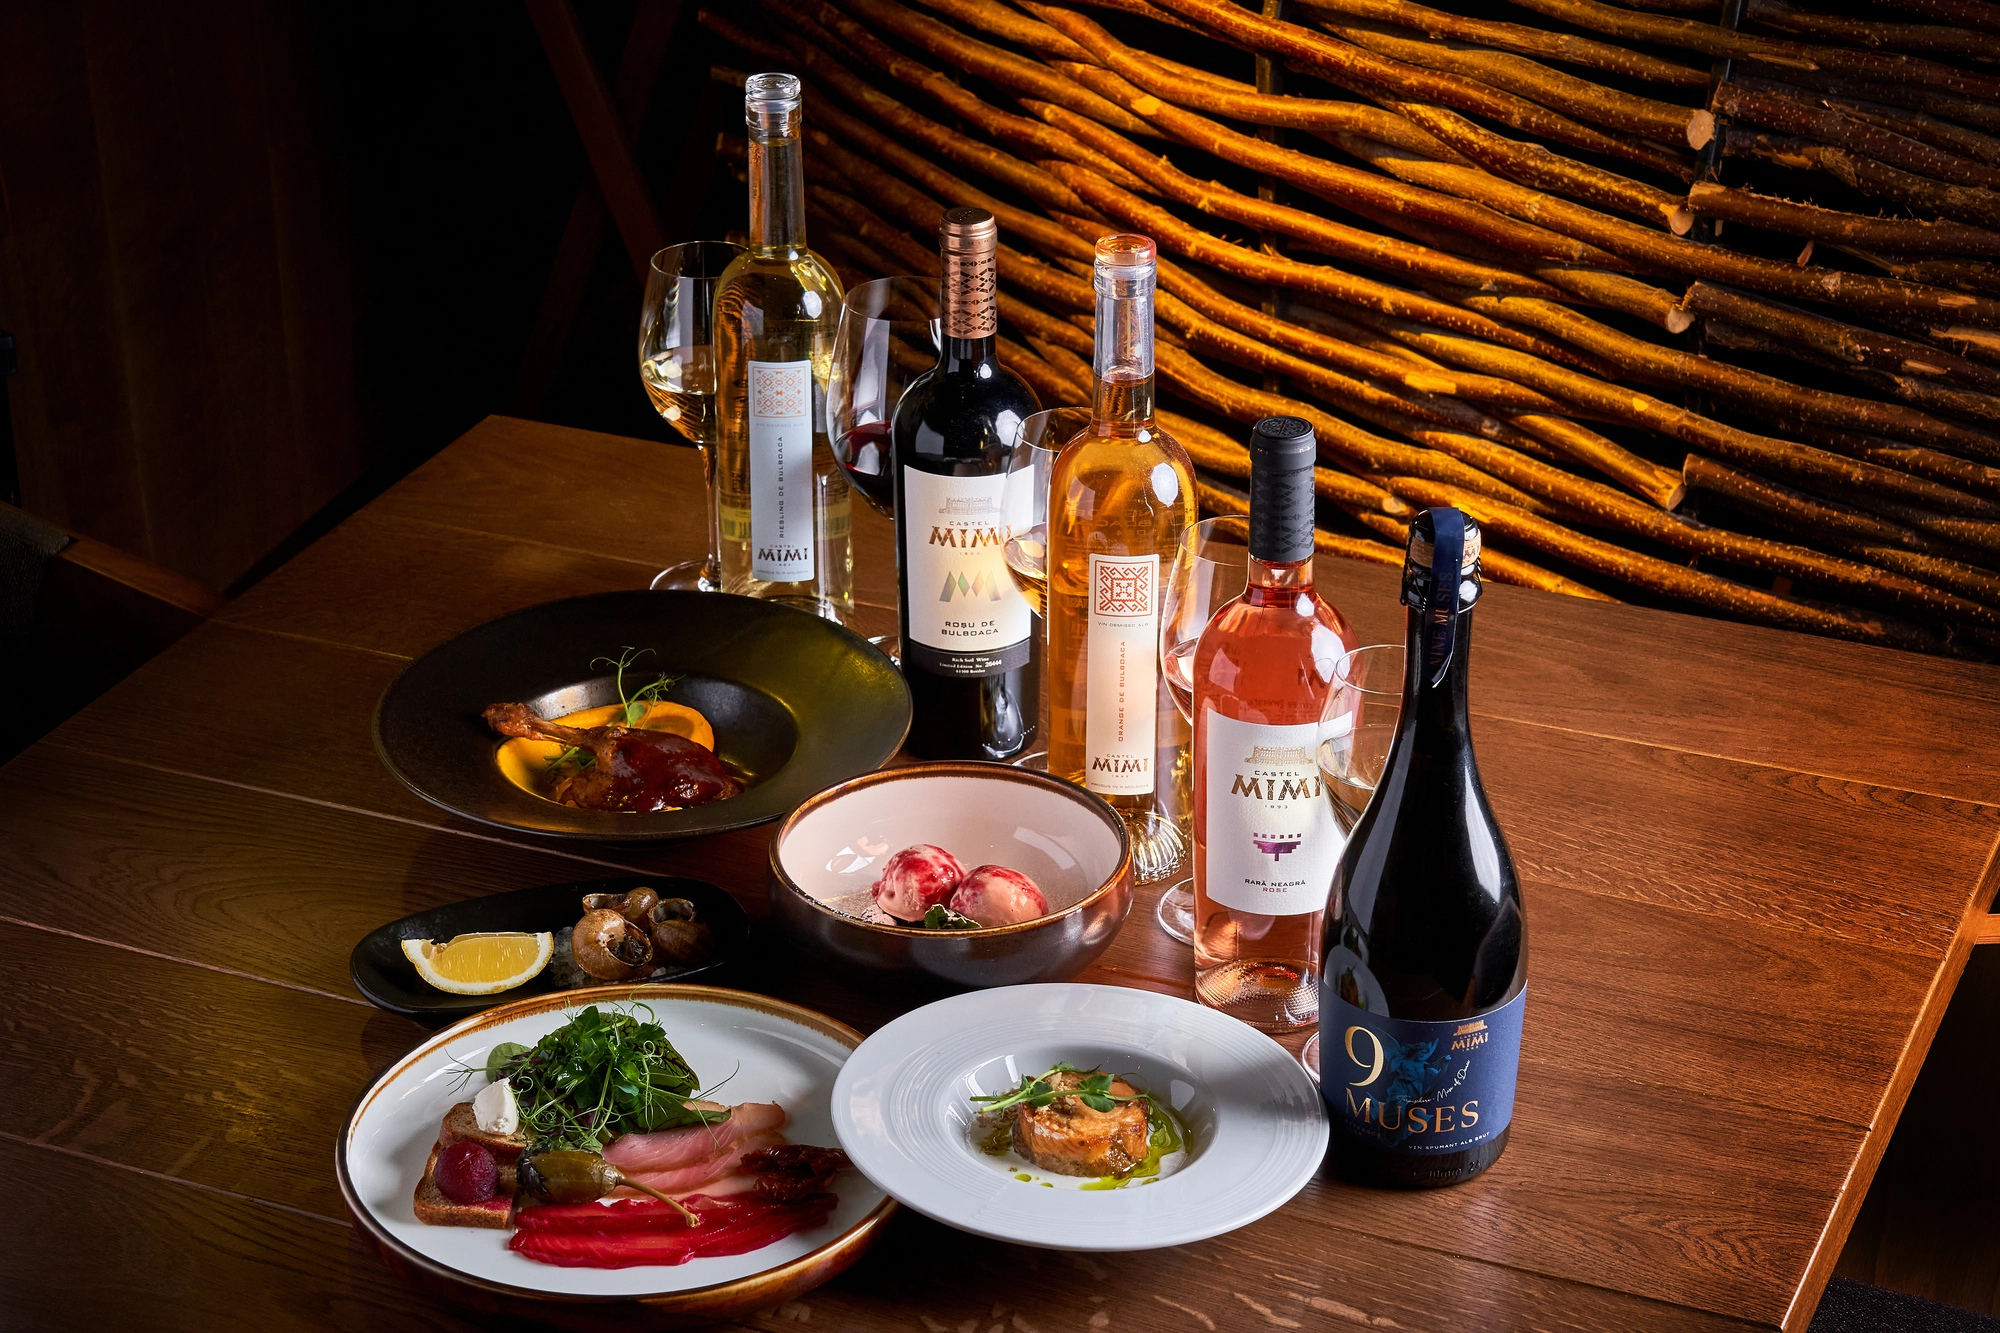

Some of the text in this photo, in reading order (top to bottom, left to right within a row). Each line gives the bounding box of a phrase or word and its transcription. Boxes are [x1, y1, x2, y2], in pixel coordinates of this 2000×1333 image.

[779, 486, 784, 497] DE
[929, 524, 1012, 548] MIMI
[757, 547, 808, 562] MIMI
[1429, 572, 1454, 666] NINE MUSES
[941, 628, 999, 636] BULBOACA
[1119, 692, 1125, 703] DE
[1091, 756, 1149, 773] MIMI
[1231, 773, 1321, 801] MIMI
[1451, 1032, 1489, 1051] MIMI
[1344, 1025, 1385, 1087] 9
[1345, 1087, 1480, 1135] MUSES
[1425, 1142, 1458, 1150] SPUMANT
[1460, 1138, 1473, 1146] ALB
[1474, 1131, 1490, 1142] BRUT
